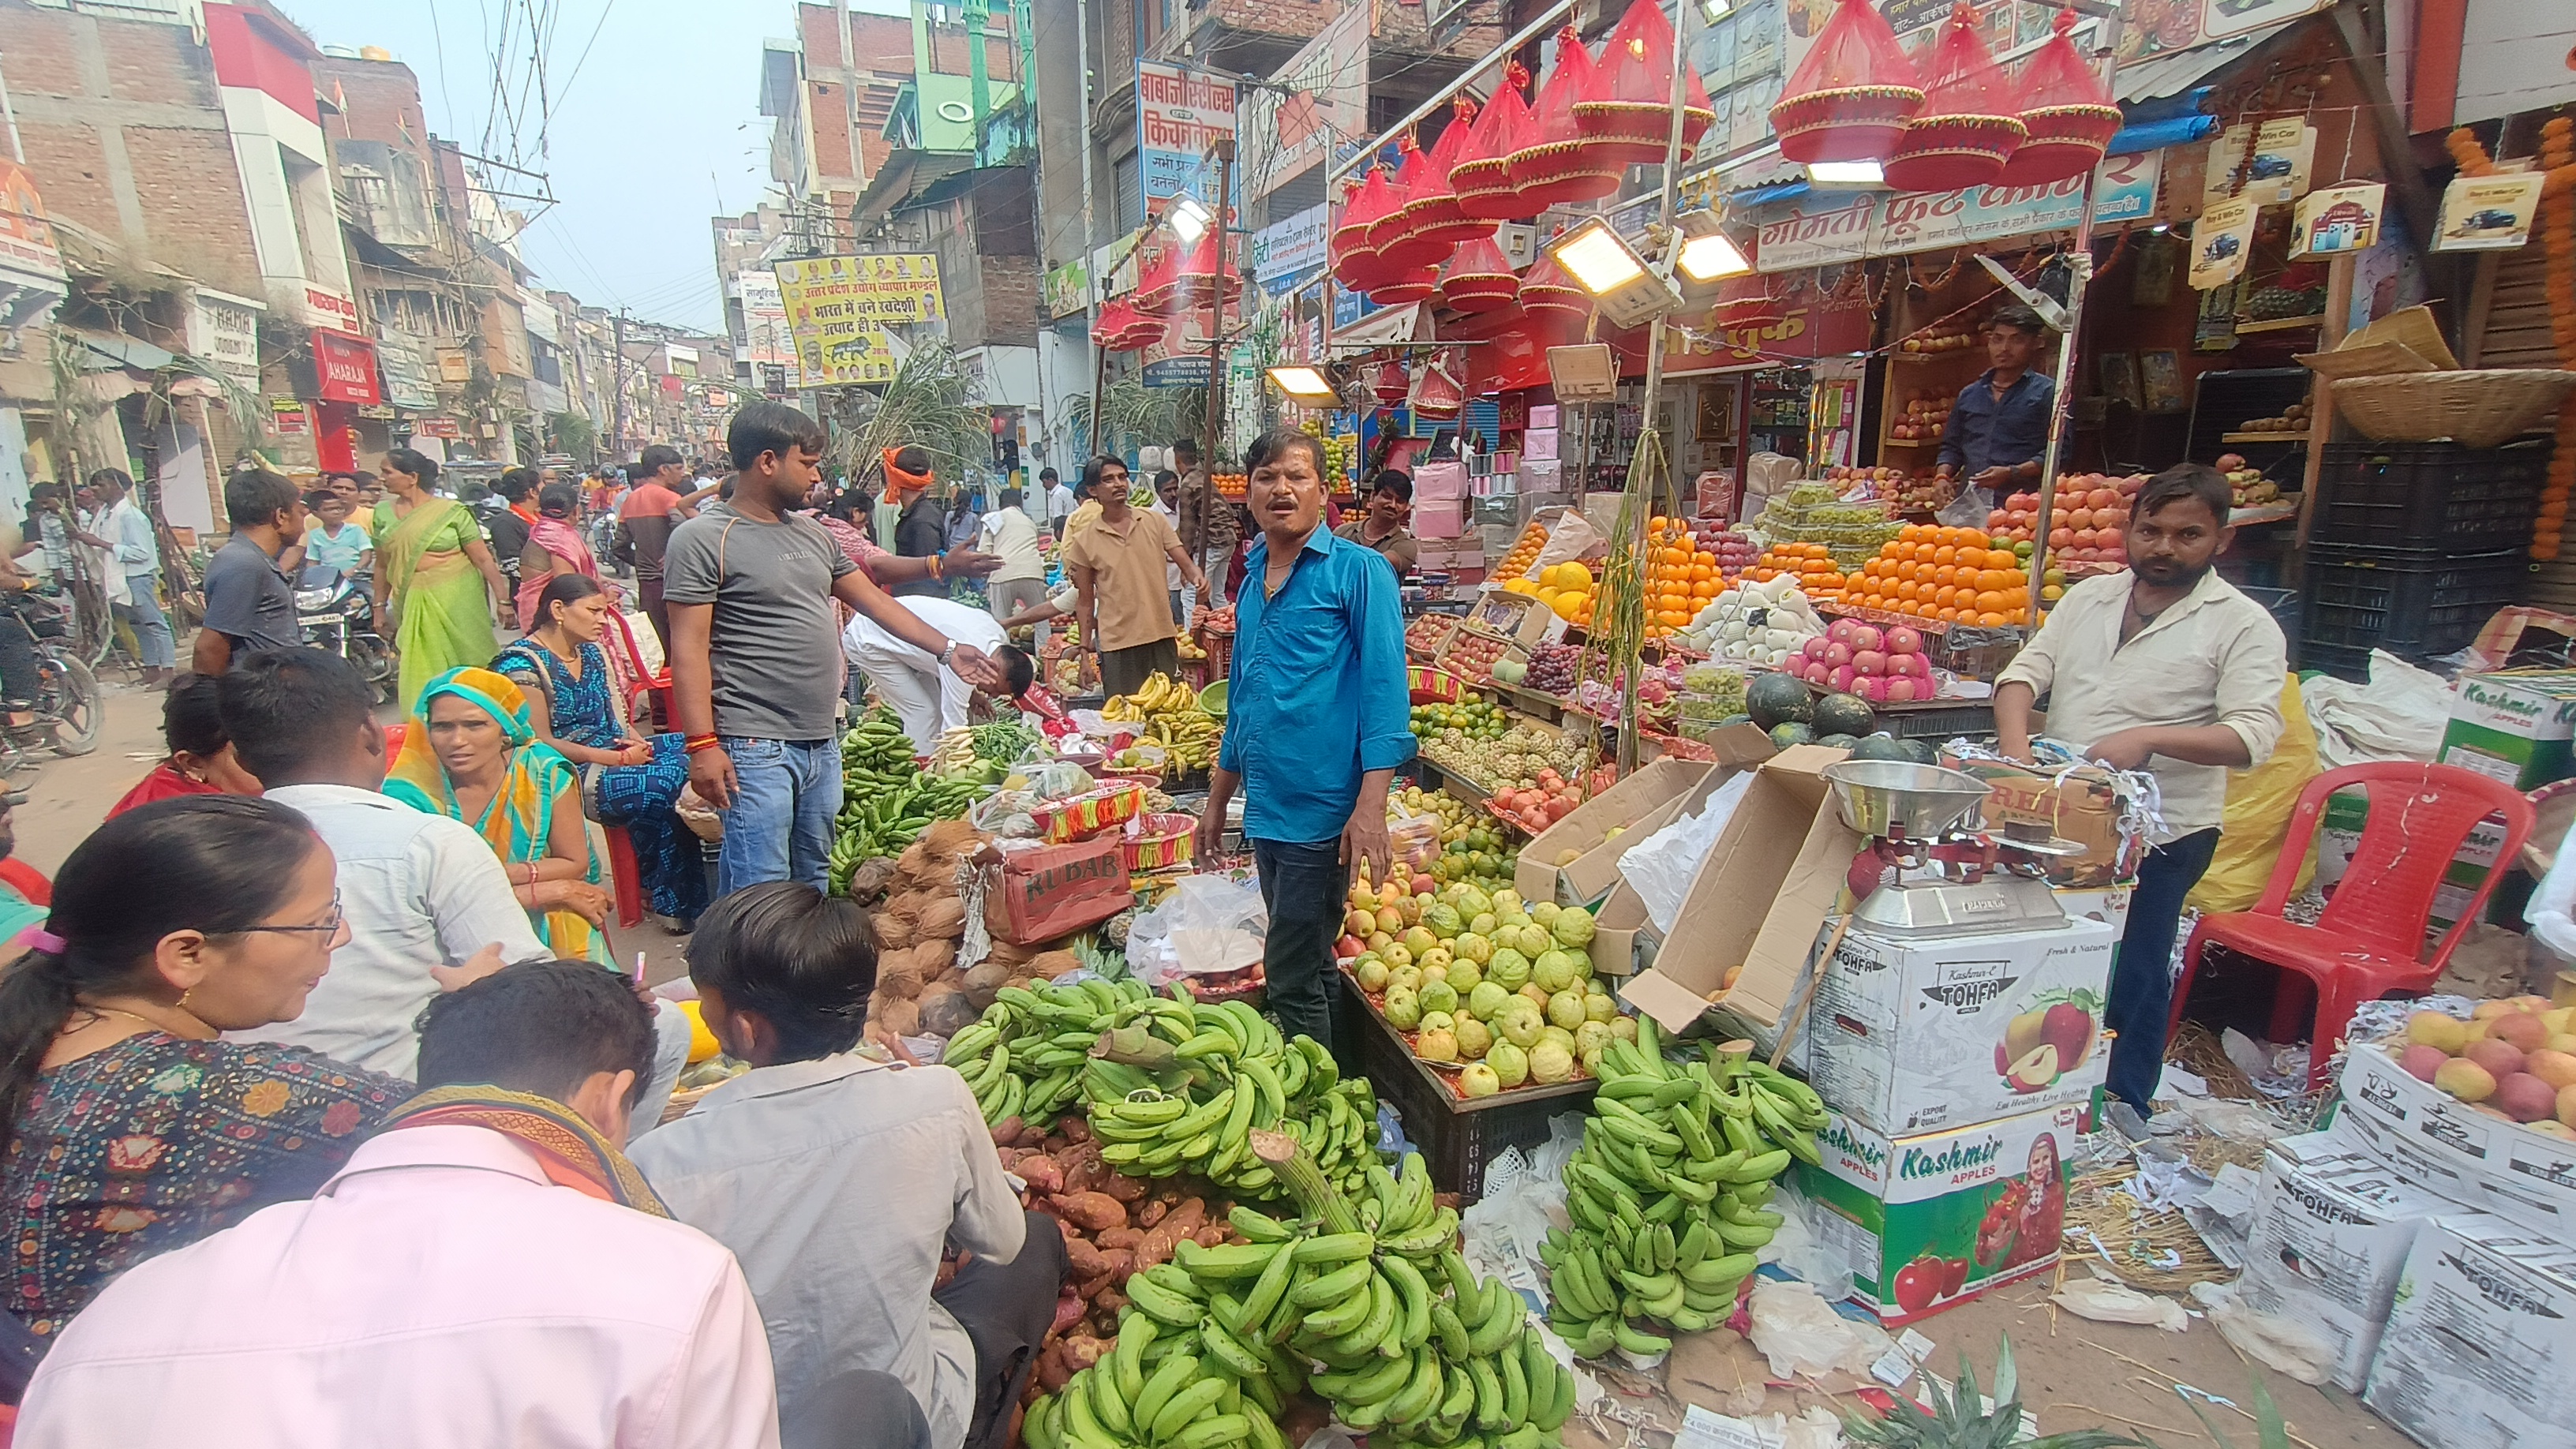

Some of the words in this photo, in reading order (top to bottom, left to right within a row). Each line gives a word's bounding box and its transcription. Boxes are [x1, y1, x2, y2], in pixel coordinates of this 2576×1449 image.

[1761, 193, 1876, 246] गोमती
[827, 284, 850, 296] प्रदेश
[814, 303, 843, 318] भारत
[844, 299, 855, 316] में
[857, 316, 869, 333] ही
[2463, 682, 2543, 717] Kashmir
[2492, 713, 2533, 728] APPLES
[1988, 784, 2069, 818] RED
[1025, 854, 1119, 904] RUBAB
[1835, 949, 1874, 973] TOHFA
[2046, 946, 2069, 957] Fresh
[2070, 945, 2077, 954] &
[2079, 942, 2110, 953] Natural
[1941, 980, 1999, 1007] TOHFA
[1922, 1104, 1948, 1117] EXPORT
[2010, 1096, 2040, 1110] Healthy
[2042, 1093, 2059, 1103] Live
[2061, 1088, 2088, 1102] Healthy
[1920, 1114, 1948, 1128] QUALITY
[1816, 1126, 1886, 1168] ashmir
[1900, 1135, 2003, 1181] Kashmir
[1840, 1157, 1879, 1182] APPLES
[1950, 1164, 1996, 1185] APPLES
[2292, 1186, 2353, 1225] TOHFA
[2464, 1266, 2539, 1315] TOHFA
